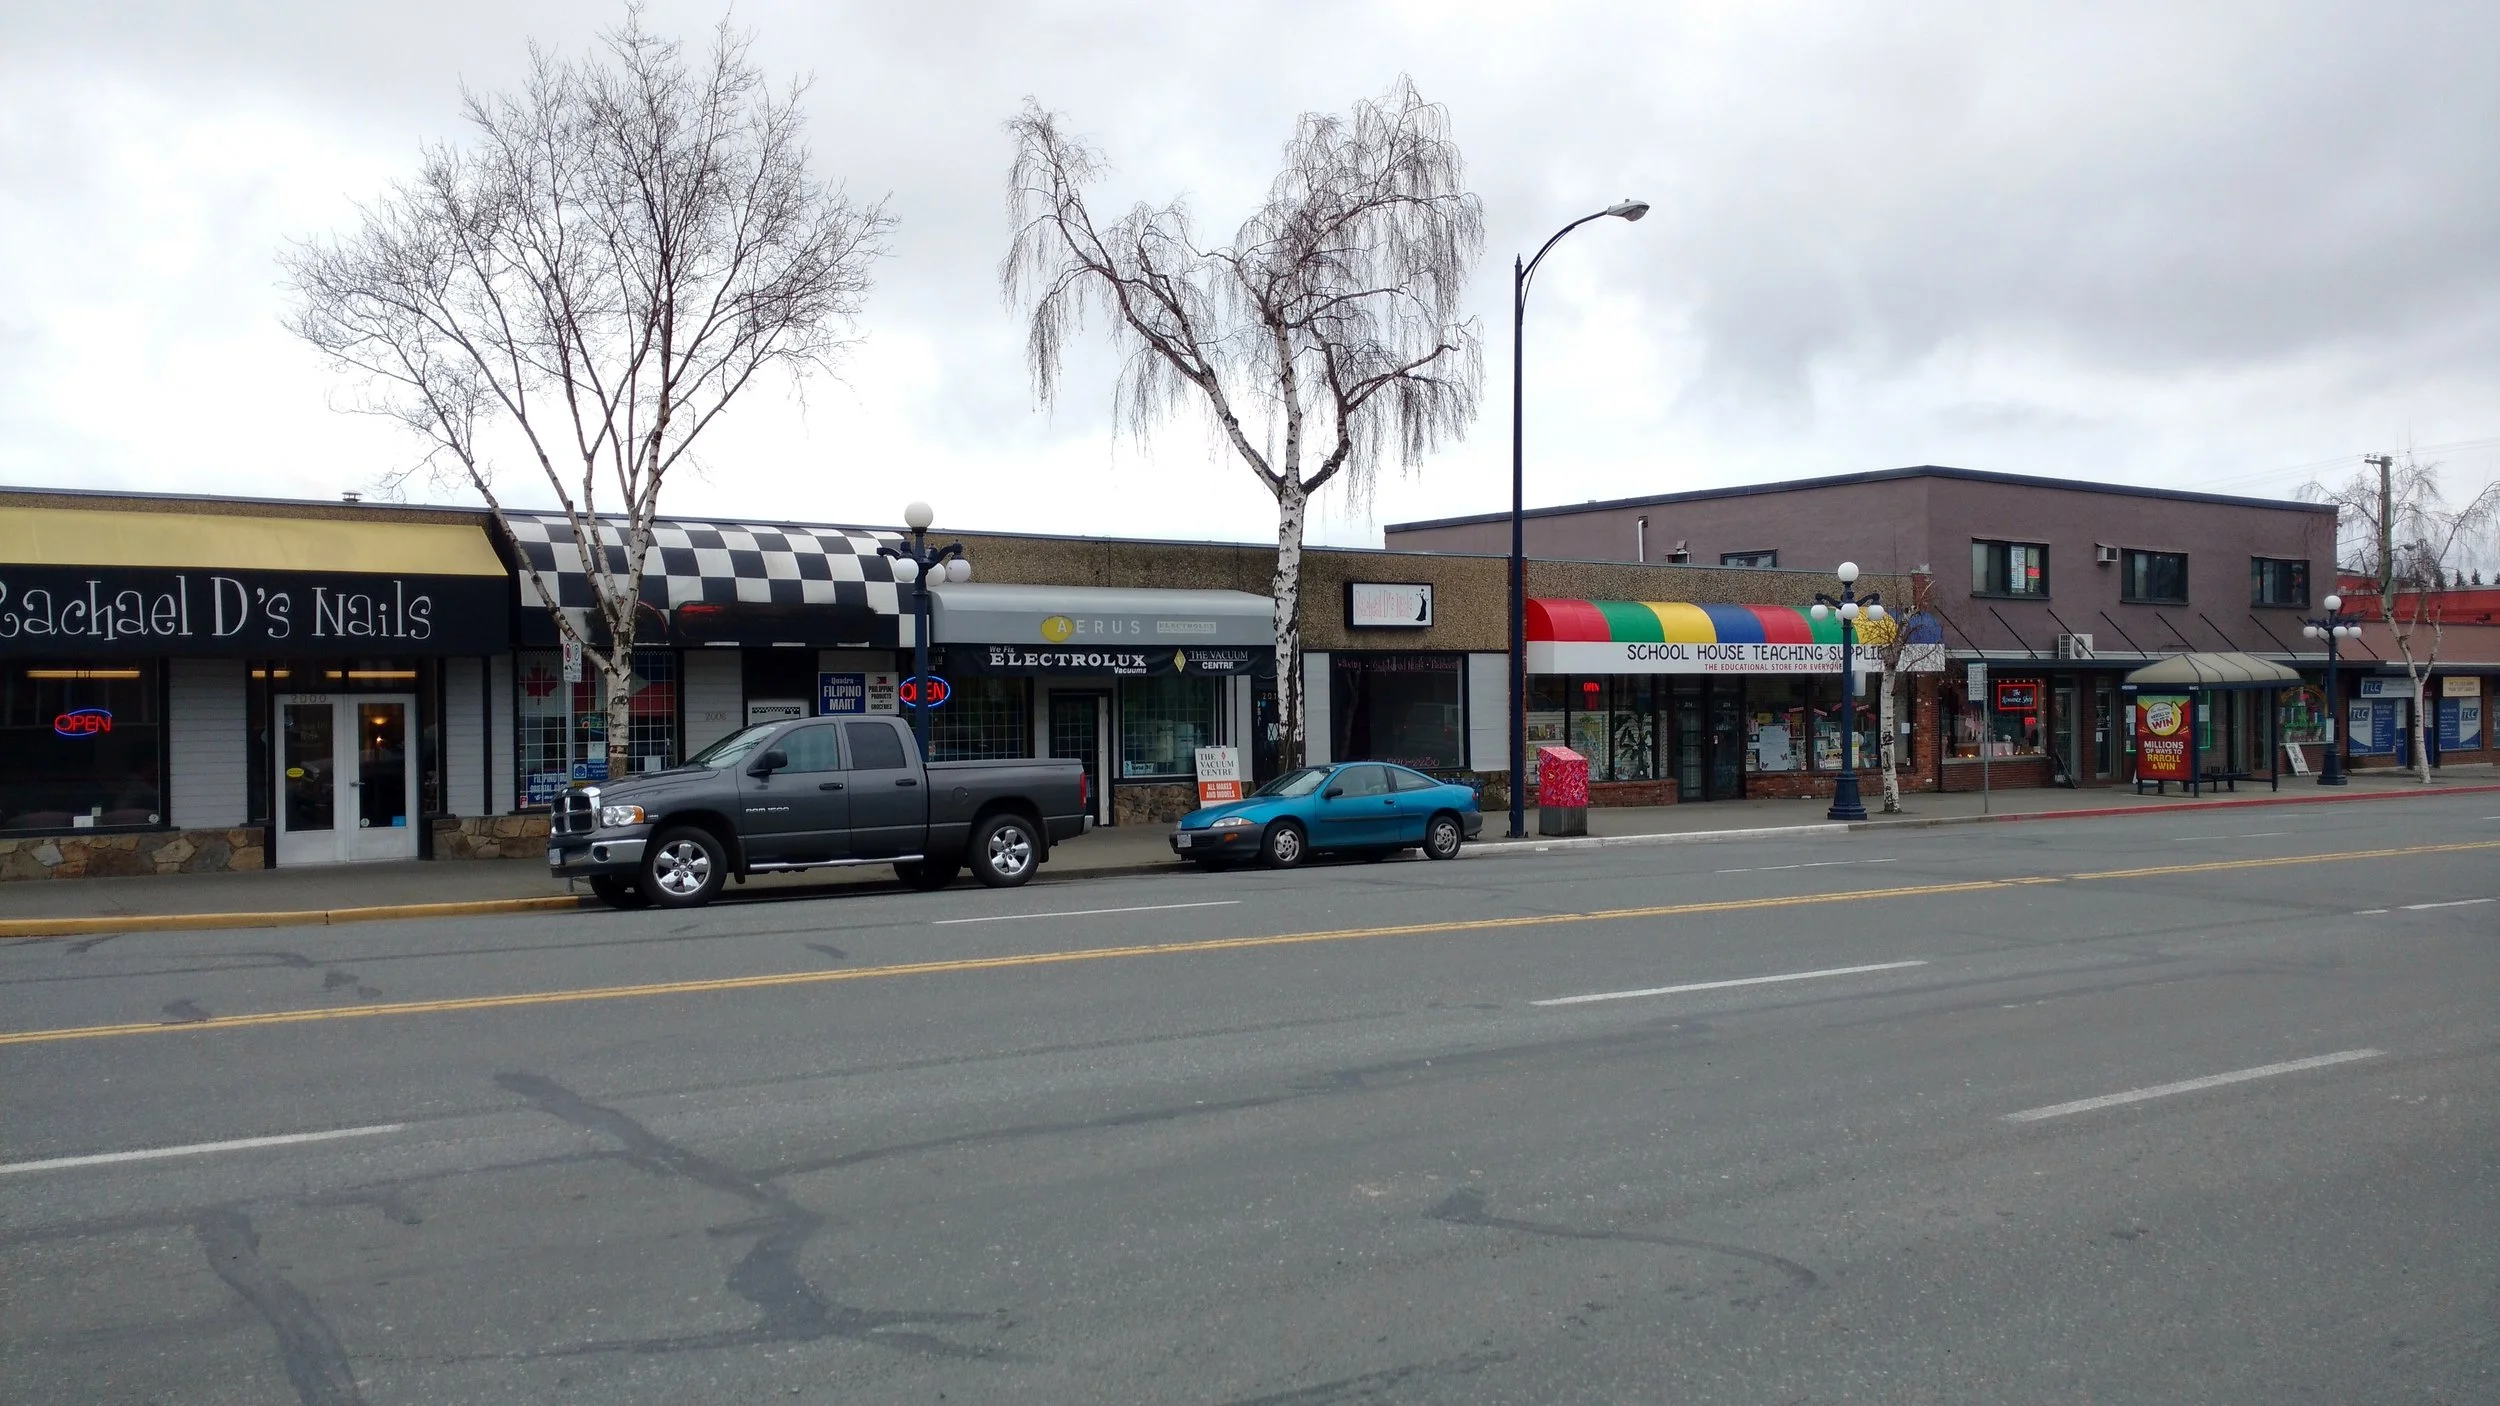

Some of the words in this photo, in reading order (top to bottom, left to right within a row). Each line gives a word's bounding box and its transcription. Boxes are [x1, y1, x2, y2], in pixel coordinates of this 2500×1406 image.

[211, 577, 290, 638] D's
[311, 580, 431, 639] Nails
[1057, 620, 1140, 634] AERUS
[989, 645, 1001, 653] We
[1003, 645, 1015, 653] Fix
[1627, 644, 1689, 660] SCHOOL
[1697, 644, 1745, 660] HOUSE
[1752, 645, 1823, 661] TEACHING
[989, 652, 1147, 667] ELECTROLUX
[1190, 650, 1207, 660] THE
[1209, 650, 1249, 660] VACUUM
[1113, 666, 1147, 674] Vacuums
[1704, 663, 1718, 671] THE
[1721, 663, 1768, 671] EDUCATIONAL
[1771, 663, 1792, 671] STORE
[1795, 663, 1808, 671] FOR
[1810, 663, 1843, 671] EVERYONE
[831, 677, 854, 685] Quadra
[823, 685, 862, 698] FILIPINO
[901, 682, 946, 701] OEN
[1583, 682, 1600, 692] OPEN
[2365, 681, 2381, 692] TLC
[829, 698, 856, 710] MART
[2351, 708, 2368, 719] TLC
[2462, 708, 2476, 718] TLC
[54, 713, 113, 734] OPEN
[2152, 718, 2174, 730] WIN
[2143, 740, 2184, 749] MILLIONS
[1200, 753, 1216, 761] THE
[2147, 753, 2182, 763] RRROLL
[1200, 760, 1234, 769] VACUUM
[1200, 768, 1234, 777] CENTRE
[1207, 782, 1216, 791] ALL
